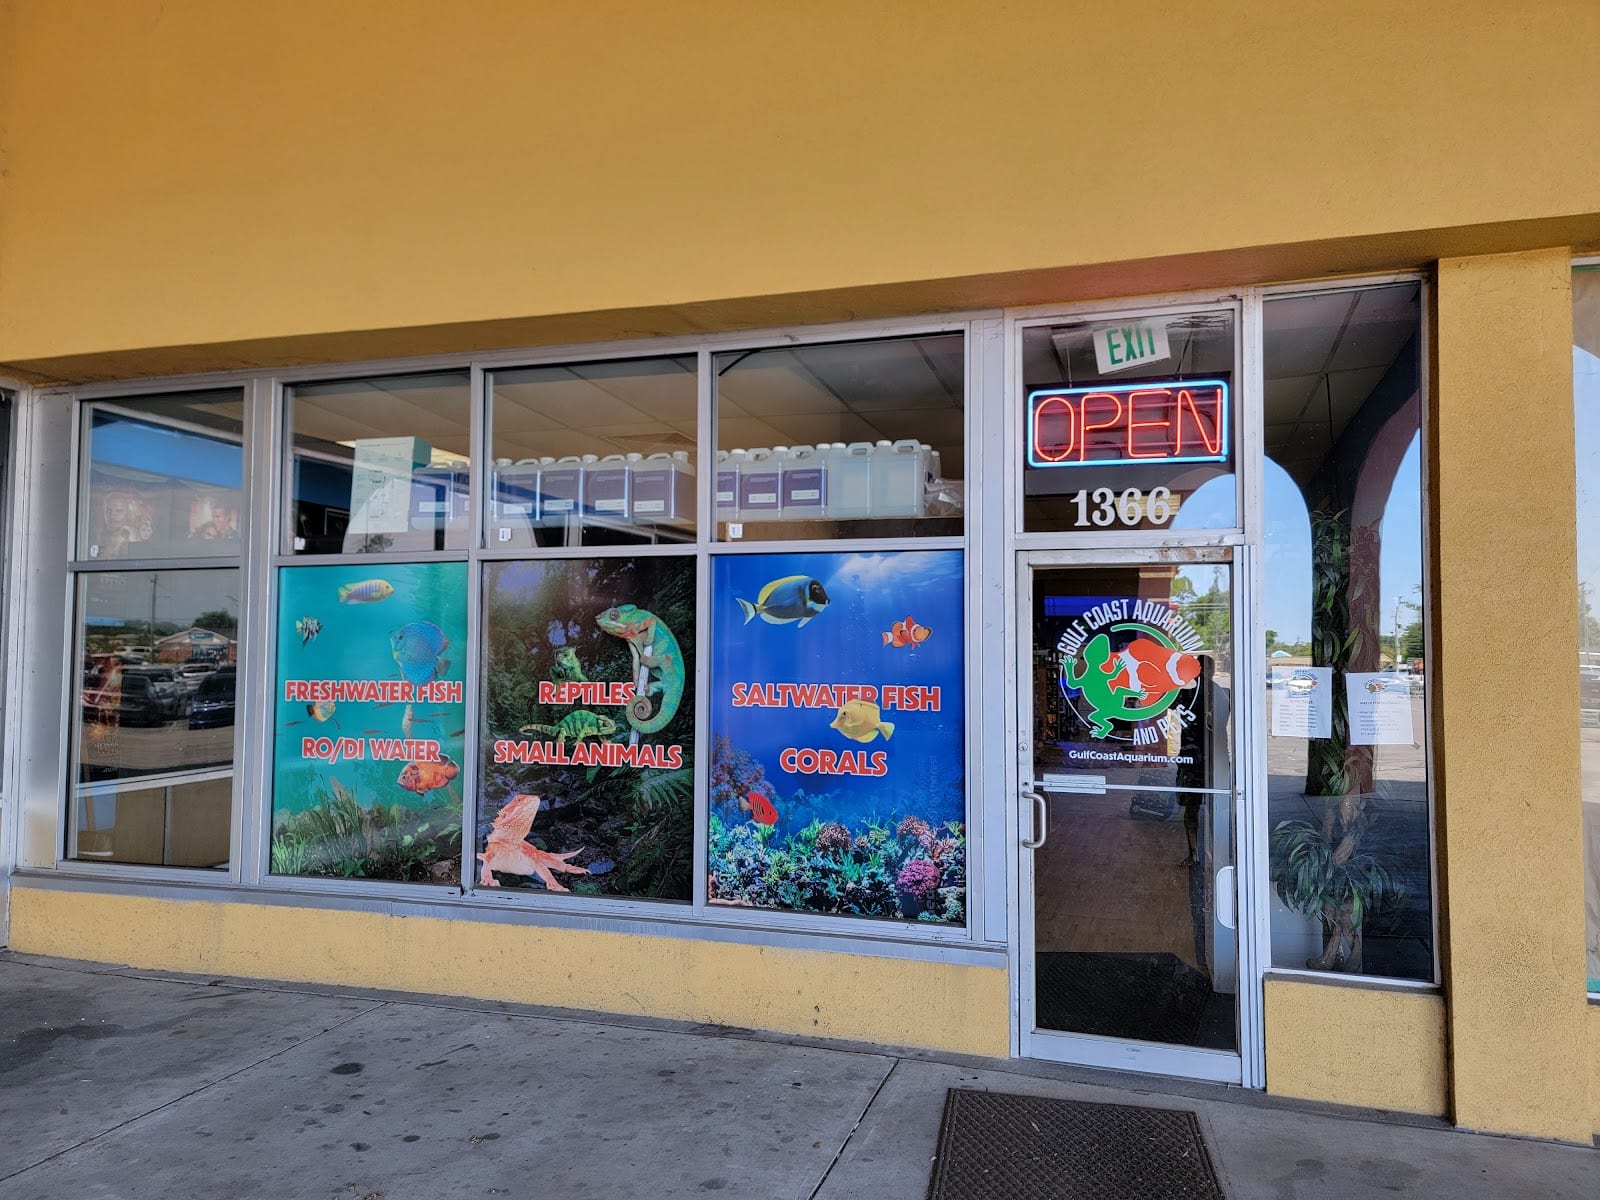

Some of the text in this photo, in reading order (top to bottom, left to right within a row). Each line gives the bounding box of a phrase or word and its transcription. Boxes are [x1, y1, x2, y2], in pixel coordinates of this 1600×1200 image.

[1034, 388, 1223, 462] OPEN
[1070, 486, 1171, 526] 1366
[1057, 599, 1205, 656] GULF COAST AQUARIUM
[285, 680, 463, 703] FRESHWATER FISH
[538, 681, 635, 705] REPTILES
[732, 682, 941, 711] SALTWATER FISH
[302, 736, 441, 762] RO/DI WATER
[1133, 726, 1160, 746] AND
[494, 740, 683, 769] SMALL ANIMALS
[780, 748, 888, 777] CORALS
[1068, 750, 1194, 765] GulfCoastAquarium.com
